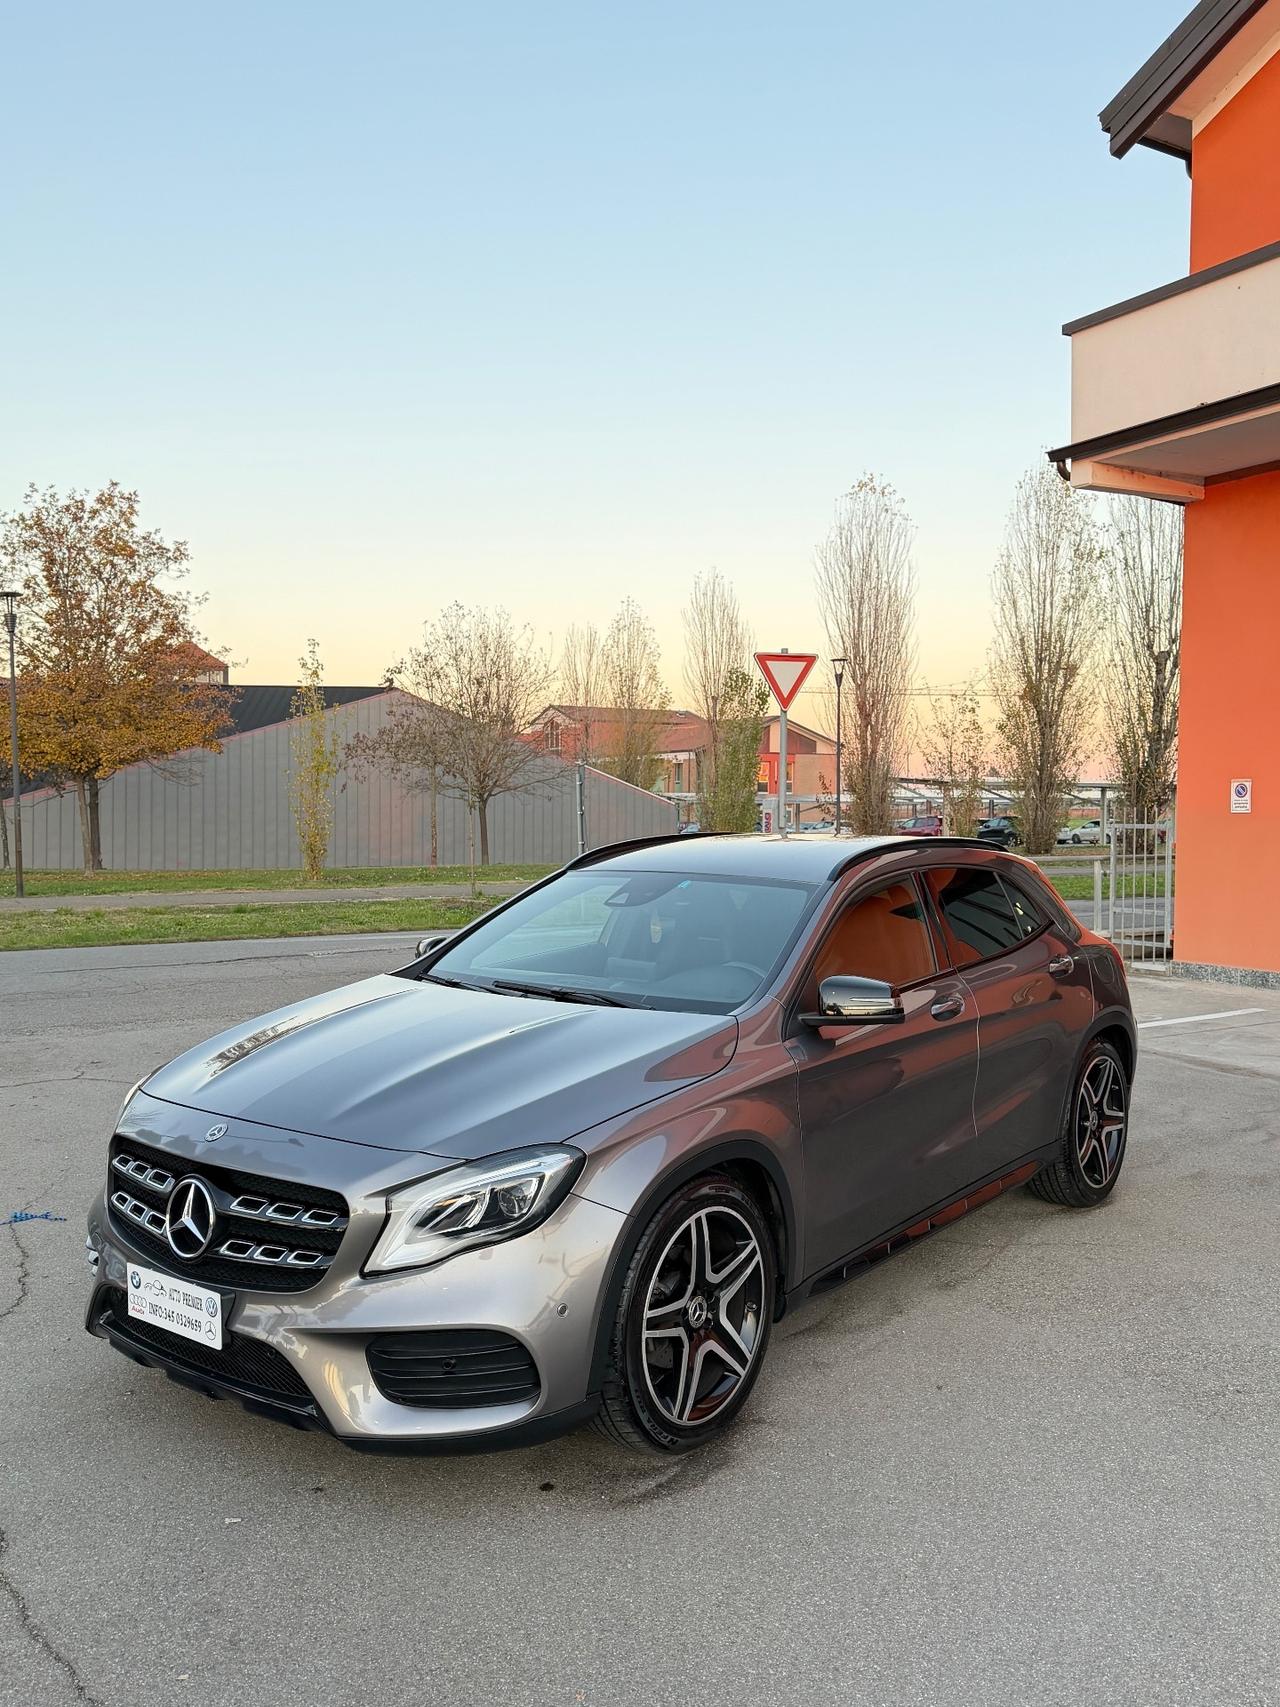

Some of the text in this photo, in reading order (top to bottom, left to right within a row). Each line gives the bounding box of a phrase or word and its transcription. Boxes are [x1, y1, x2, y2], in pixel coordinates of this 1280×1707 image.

[168, 1288, 203, 1312] AUTO PREMIER
[148, 1302, 201, 1332] INFO:345 0329659
